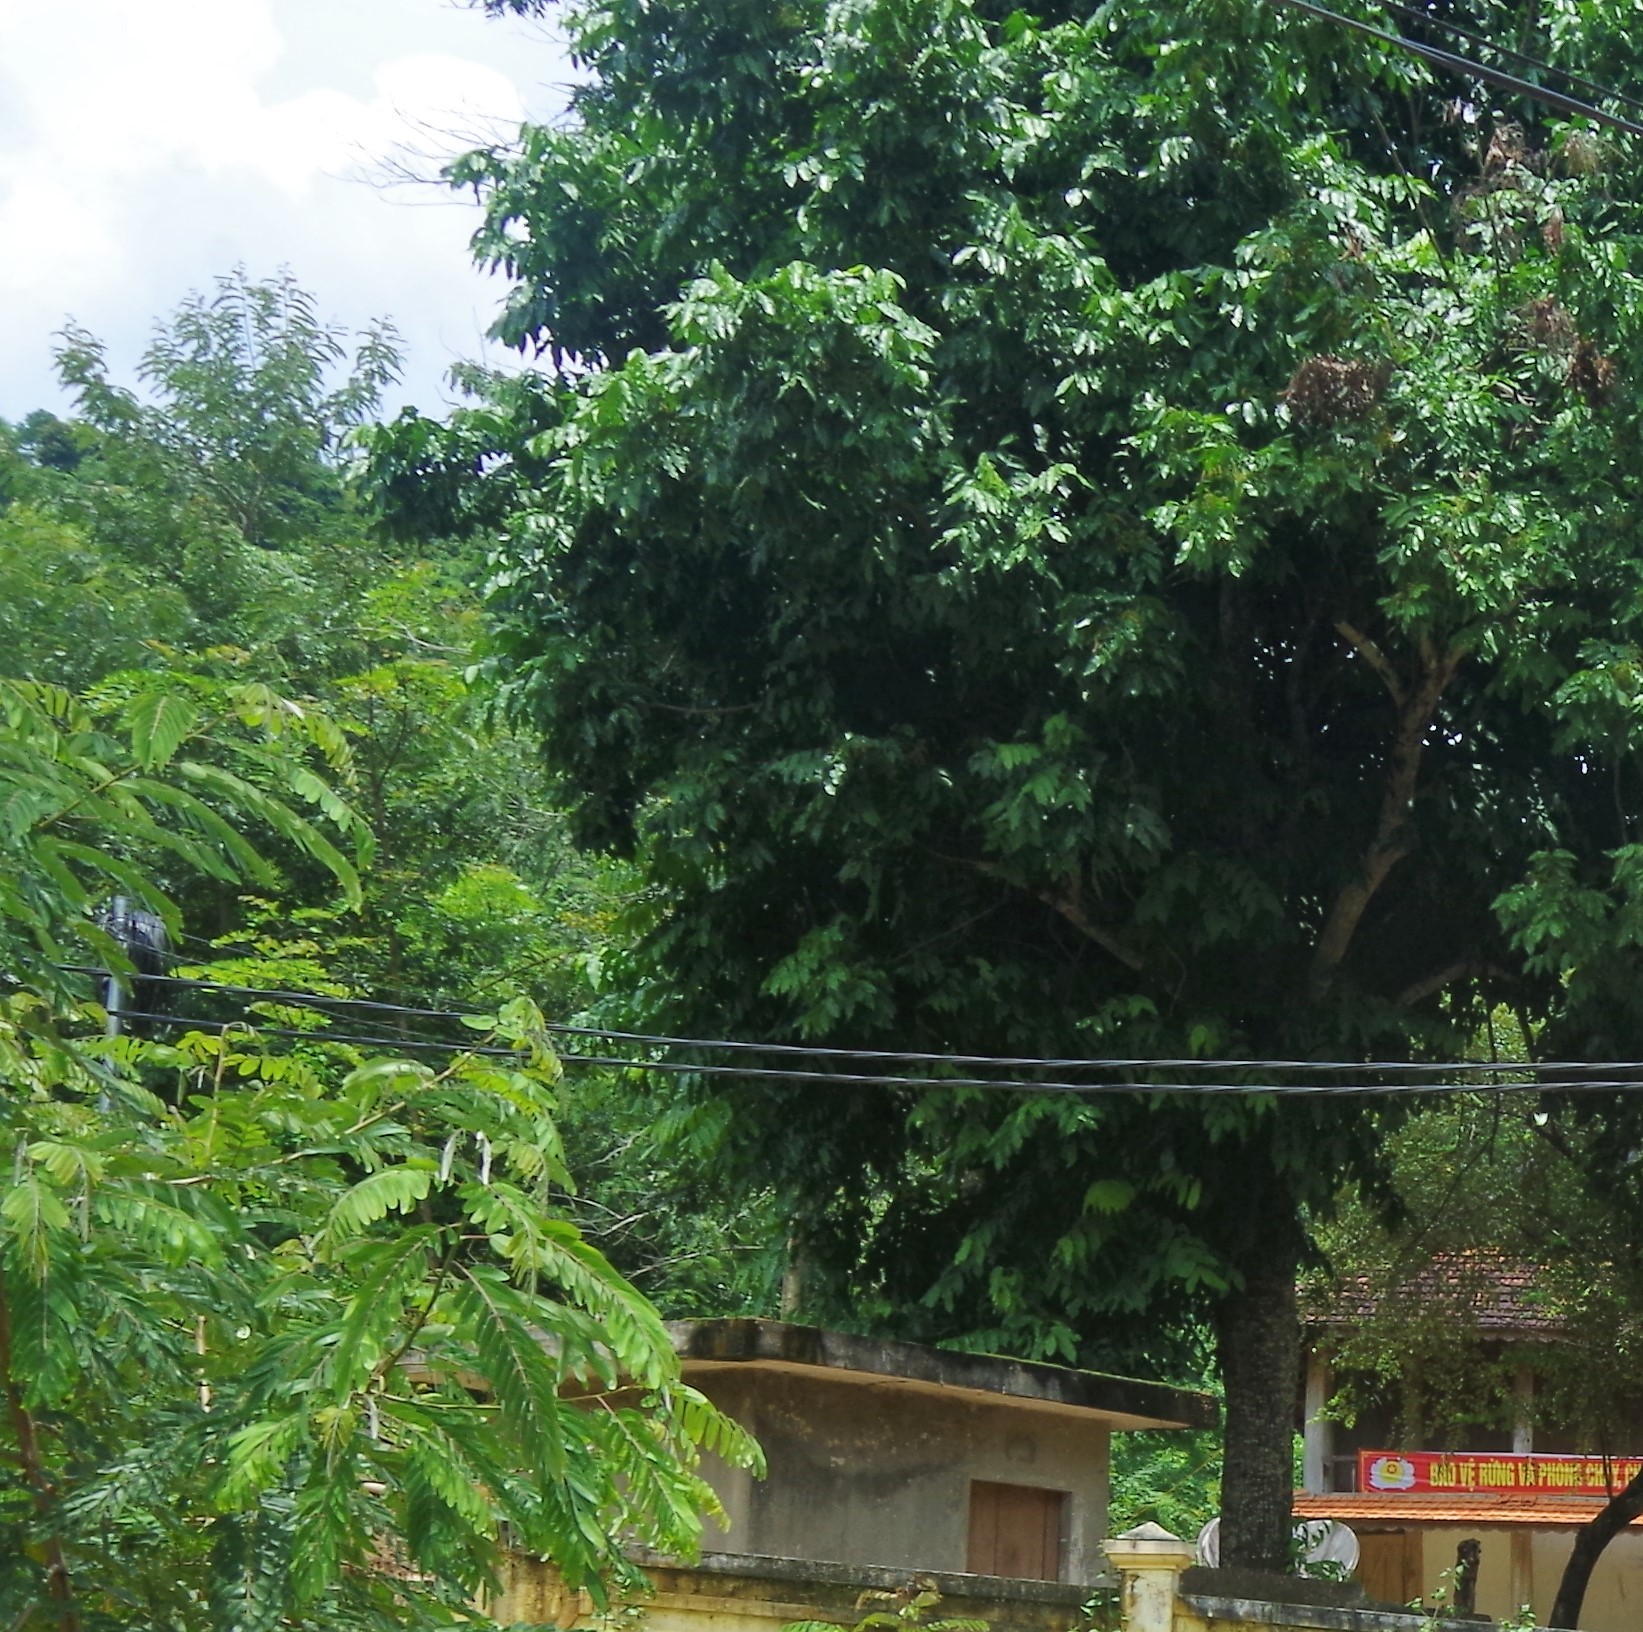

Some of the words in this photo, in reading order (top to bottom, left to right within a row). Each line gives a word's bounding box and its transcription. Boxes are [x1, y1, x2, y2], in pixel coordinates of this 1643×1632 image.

[1429, 1454, 1456, 1487] BẢO
[1459, 1457, 1476, 1492] VỆ
[1479, 1458, 1515, 1487] RỪNG
[1518, 1457, 1536, 1488] VÀ
[1538, 1458, 1582, 1487] PHÒNG
